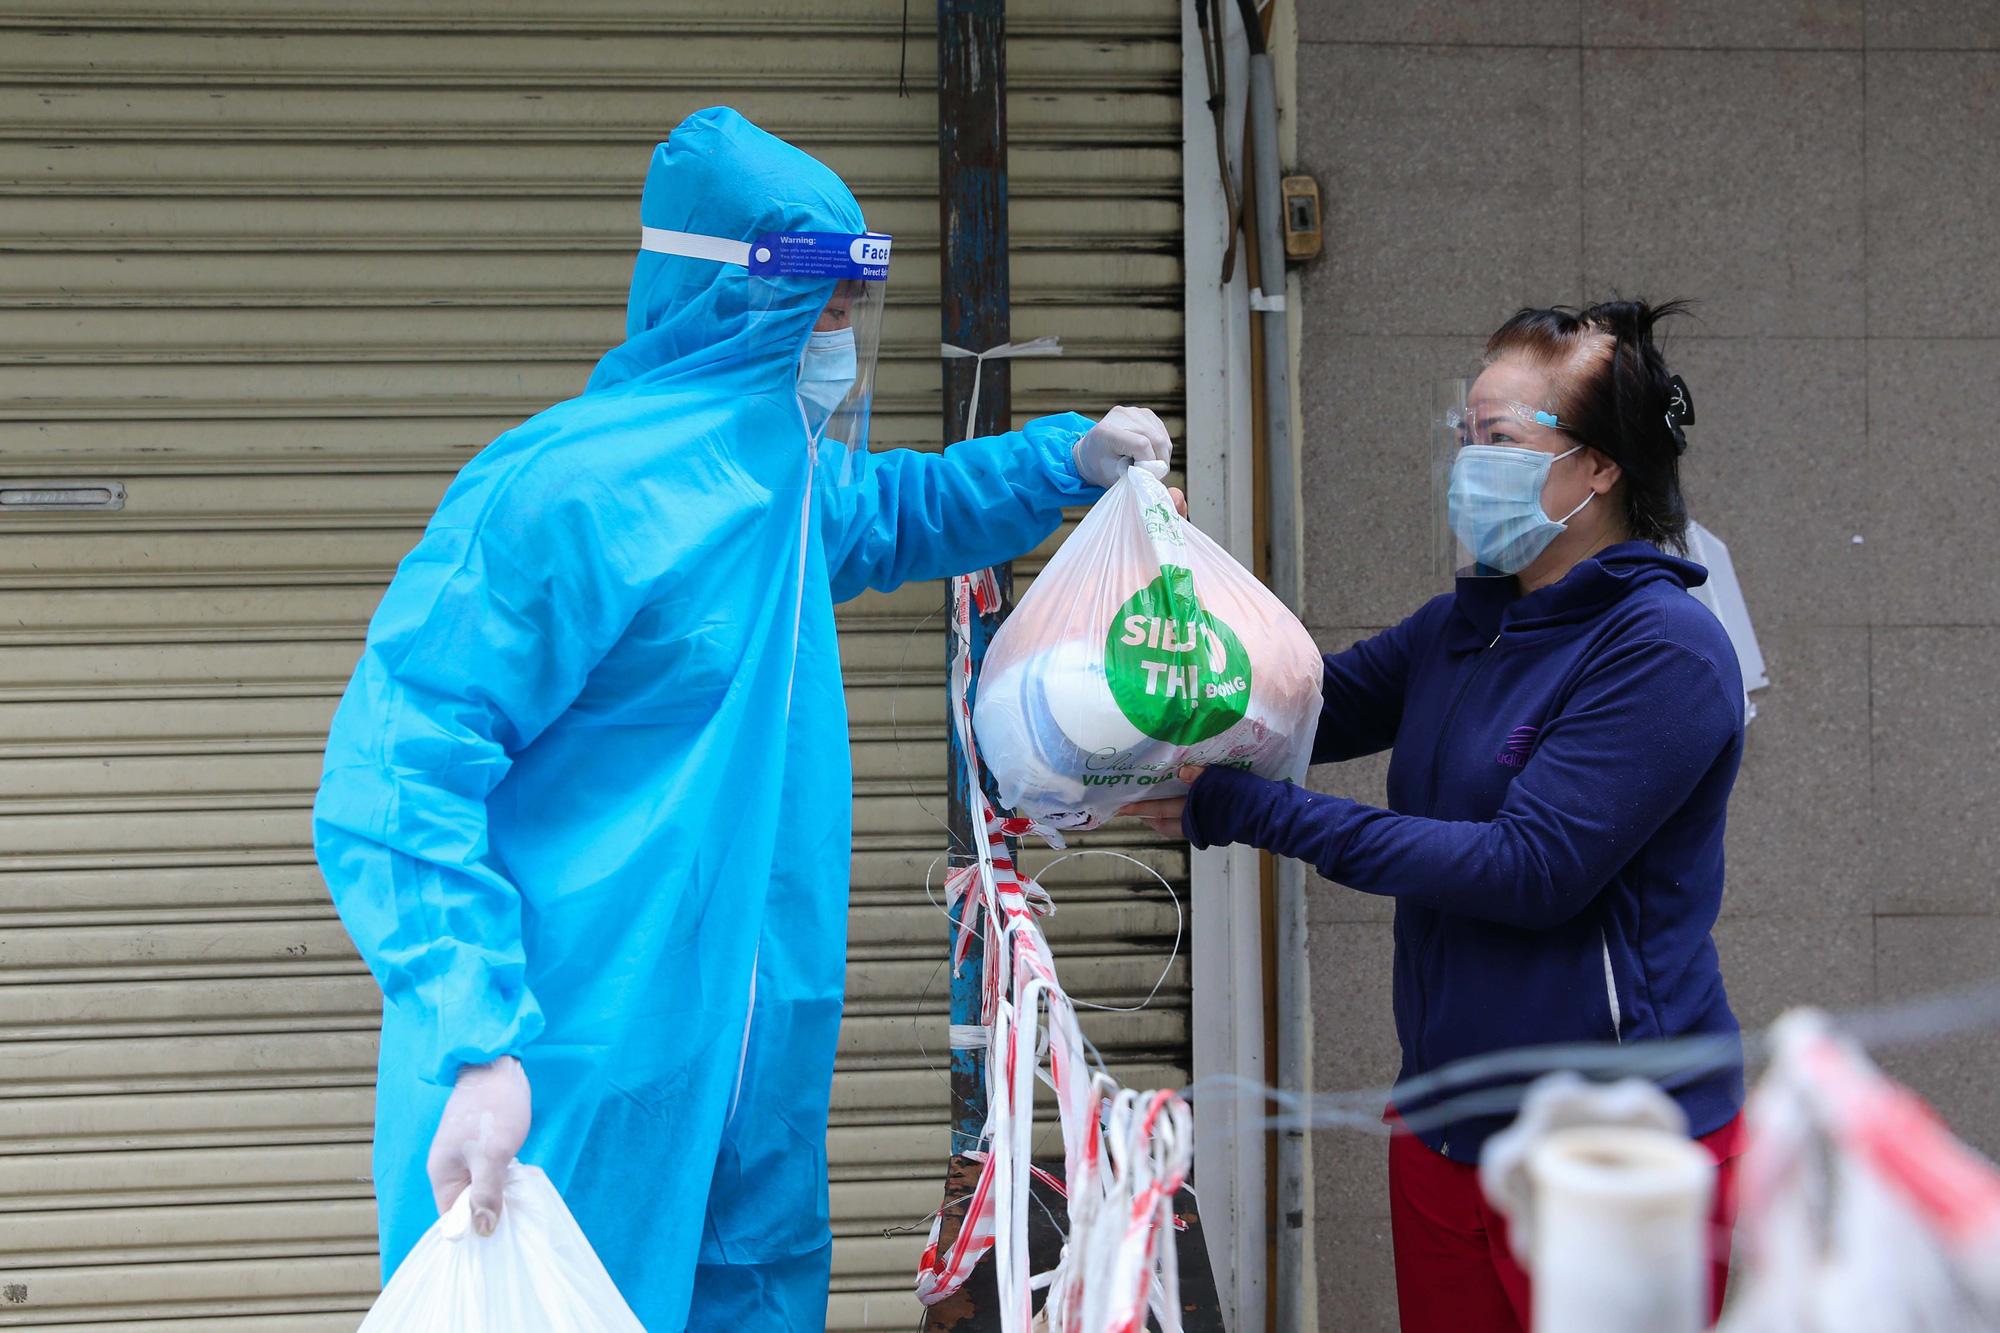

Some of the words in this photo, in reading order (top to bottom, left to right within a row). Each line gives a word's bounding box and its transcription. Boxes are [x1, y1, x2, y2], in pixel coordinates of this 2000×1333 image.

[780, 236, 817, 246] Warning:
[862, 243, 889, 260] Face
[863, 267, 880, 276] Direct
[1085, 746, 1139, 771] Chia
[1082, 773, 1135, 788] VƯỢT
